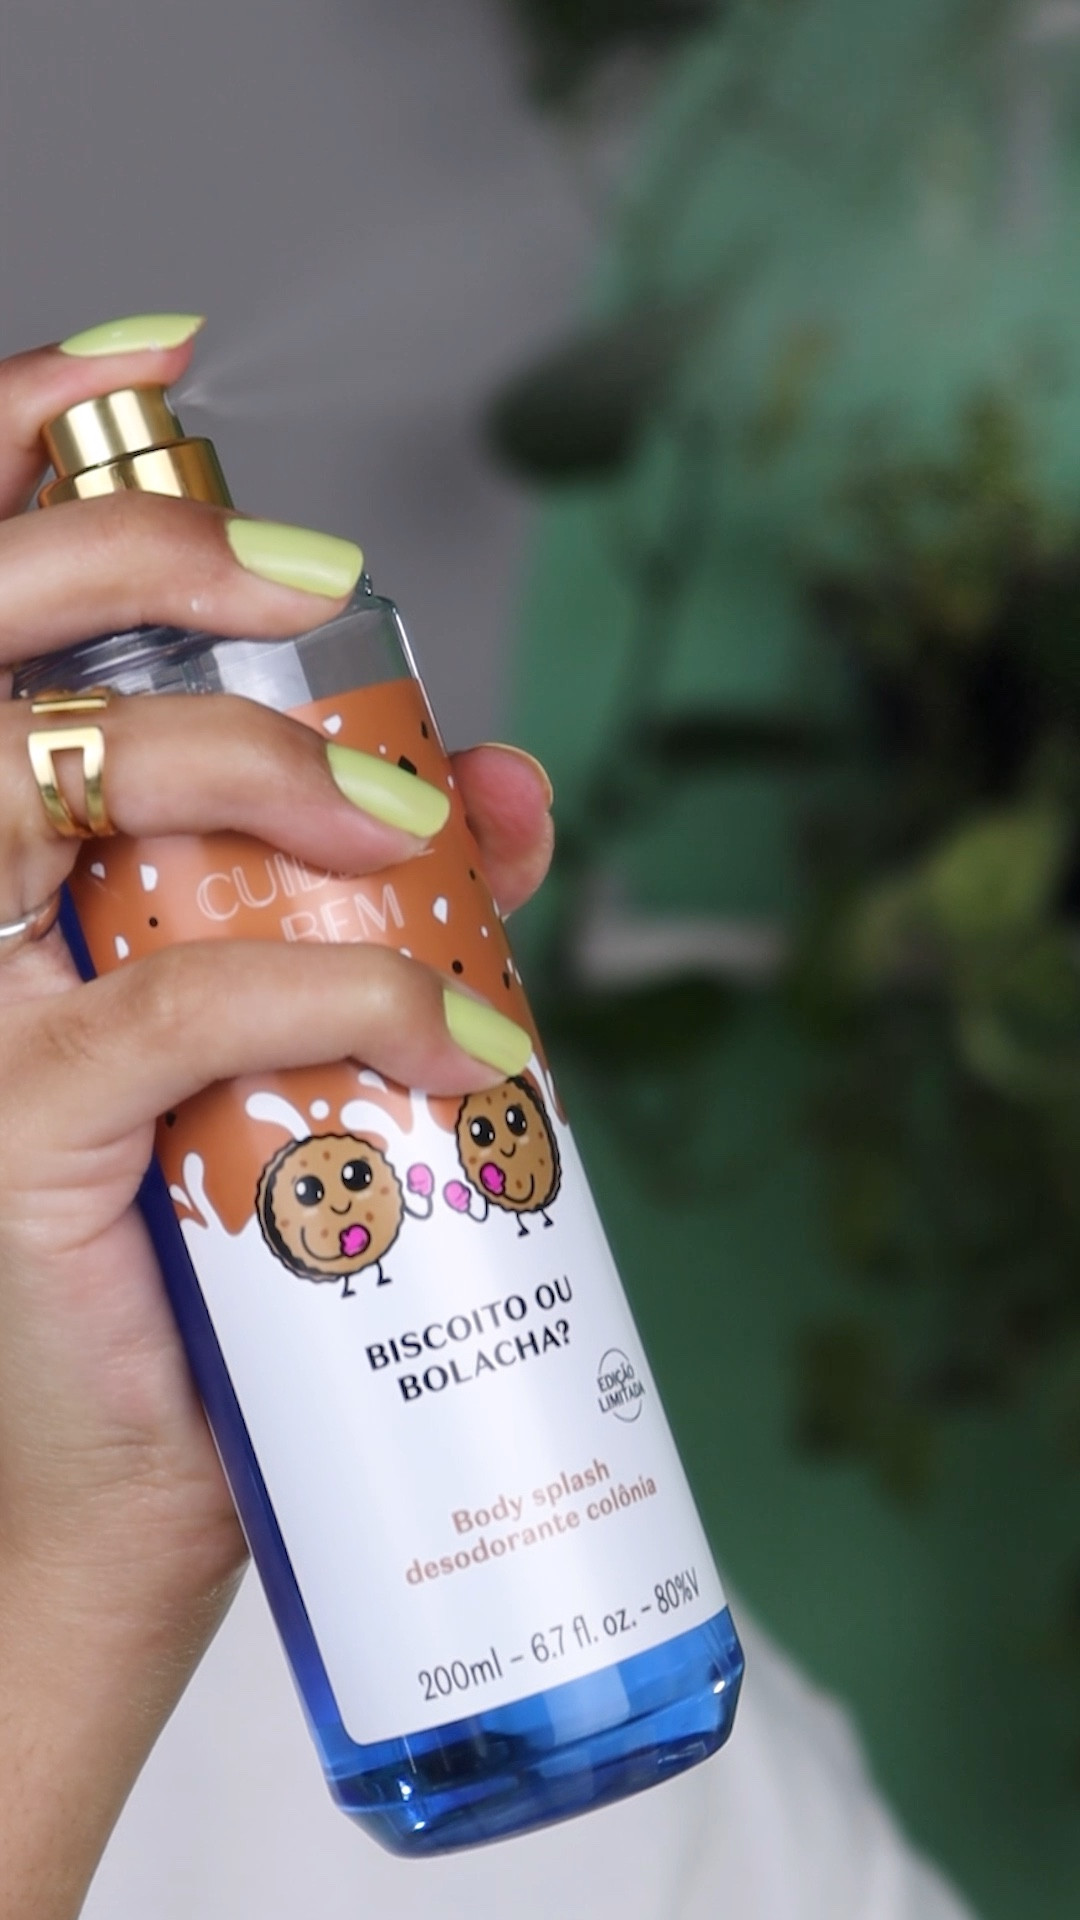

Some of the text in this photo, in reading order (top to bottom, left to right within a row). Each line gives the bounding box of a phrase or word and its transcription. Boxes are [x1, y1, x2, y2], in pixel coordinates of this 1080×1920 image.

[280, 884, 405, 943] BEM
[365, 1275, 573, 1370] BISCOITO OU
[398, 1319, 570, 1402] BOLACHA?
[597, 1362, 635, 1393] EDIÇÃO
[598, 1380, 645, 1413] LIMITADA
[405, 1476, 657, 1585] desodorante colônia
[451, 1458, 609, 1535] Body splash
[418, 1647, 503, 1701] 200ml
[531, 1624, 565, 1664] 6.7
[573, 1615, 599, 1649] fl.
[603, 1609, 637, 1637] oz.
[654, 1566, 700, 1615] 80%V
